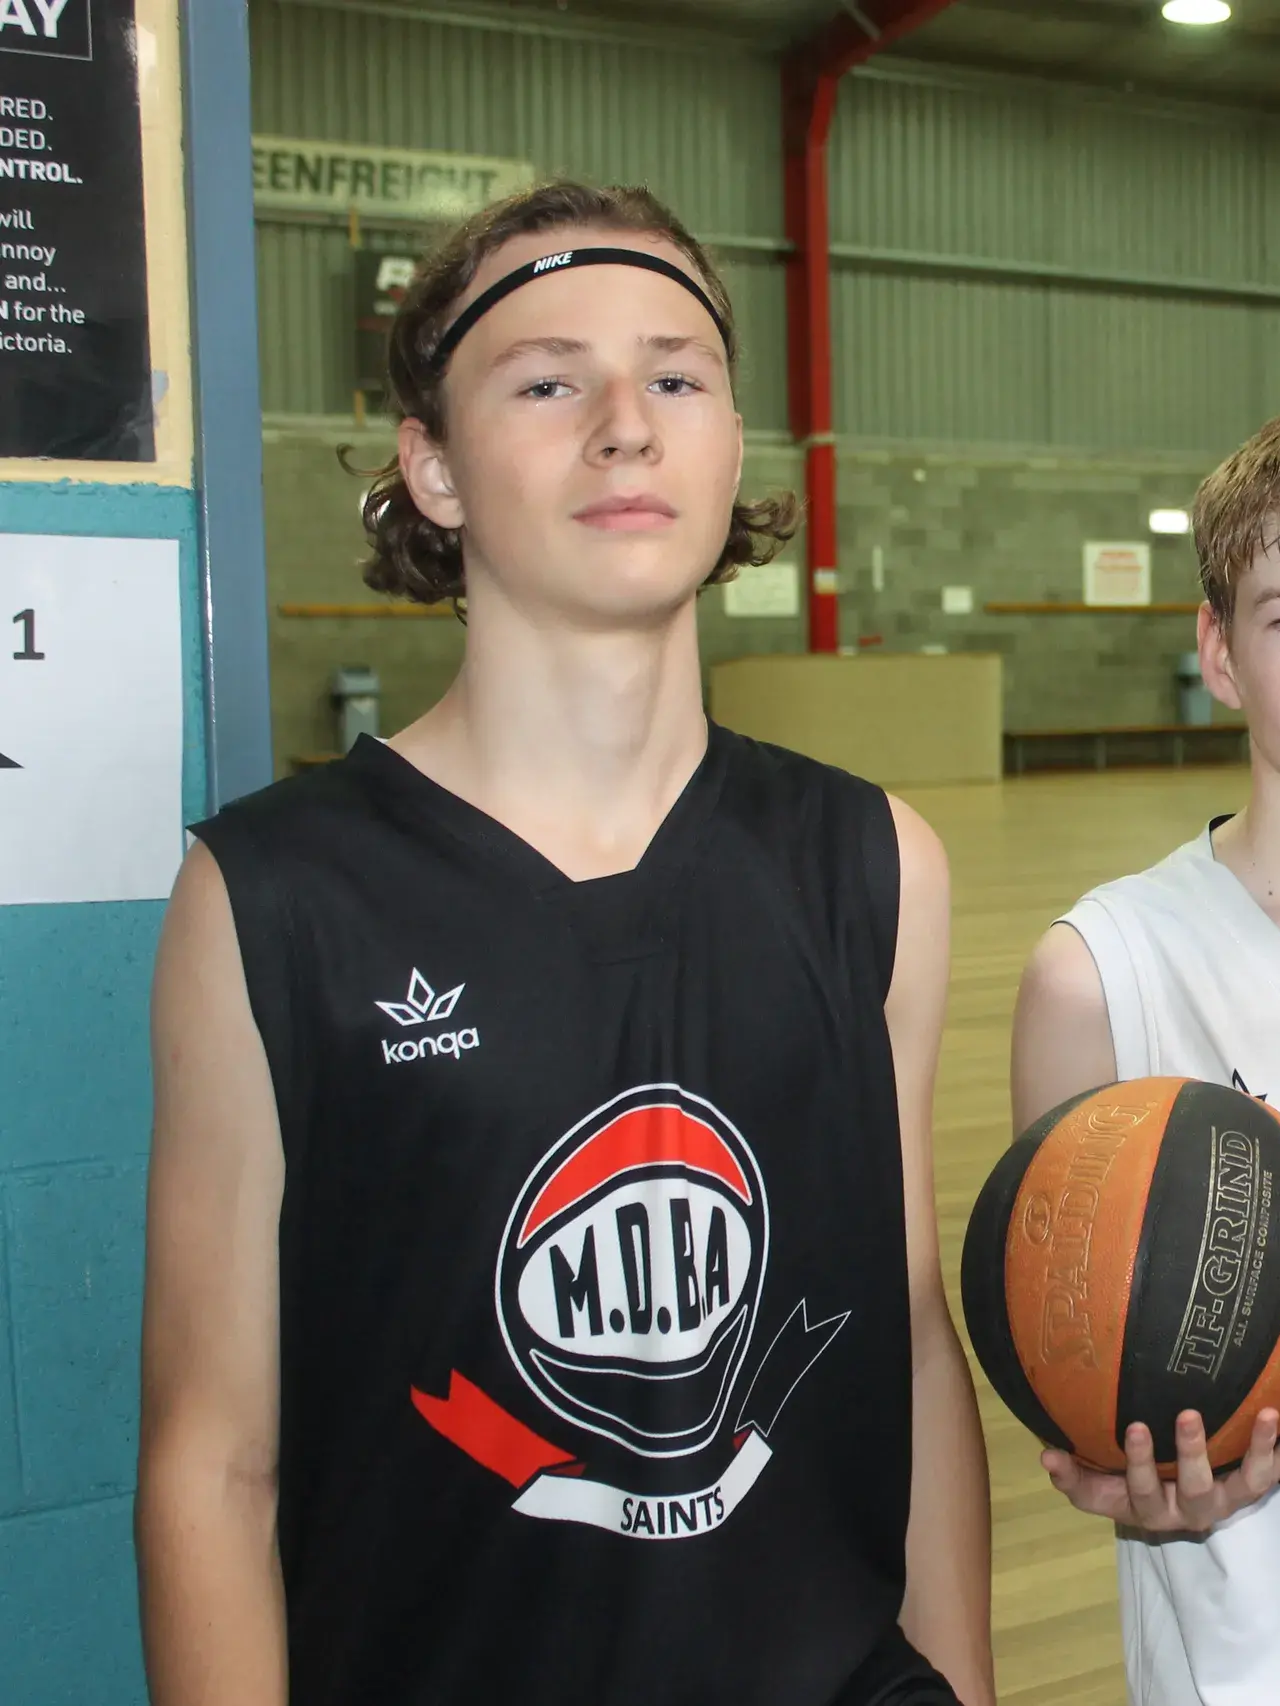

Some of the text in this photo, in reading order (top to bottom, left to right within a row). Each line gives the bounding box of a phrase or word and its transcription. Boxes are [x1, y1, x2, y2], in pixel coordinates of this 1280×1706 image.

[0, 0, 68, 38] AY
[0, 96, 53, 121] RED.
[0, 127, 52, 151] DED.
[533, 251, 573, 273] NIKE
[14, 301, 46, 322] for
[50, 303, 85, 324] the
[13, 608, 45, 660] 1
[381, 1027, 480, 1064] konqa
[1040, 1104, 1150, 1371] SPALDING
[1174, 1130, 1253, 1374] TF-GRIND
[1233, 1170, 1273, 1347] ALL SURFACE COMPOSITE
[620, 1486, 724, 1535] SAINTS
